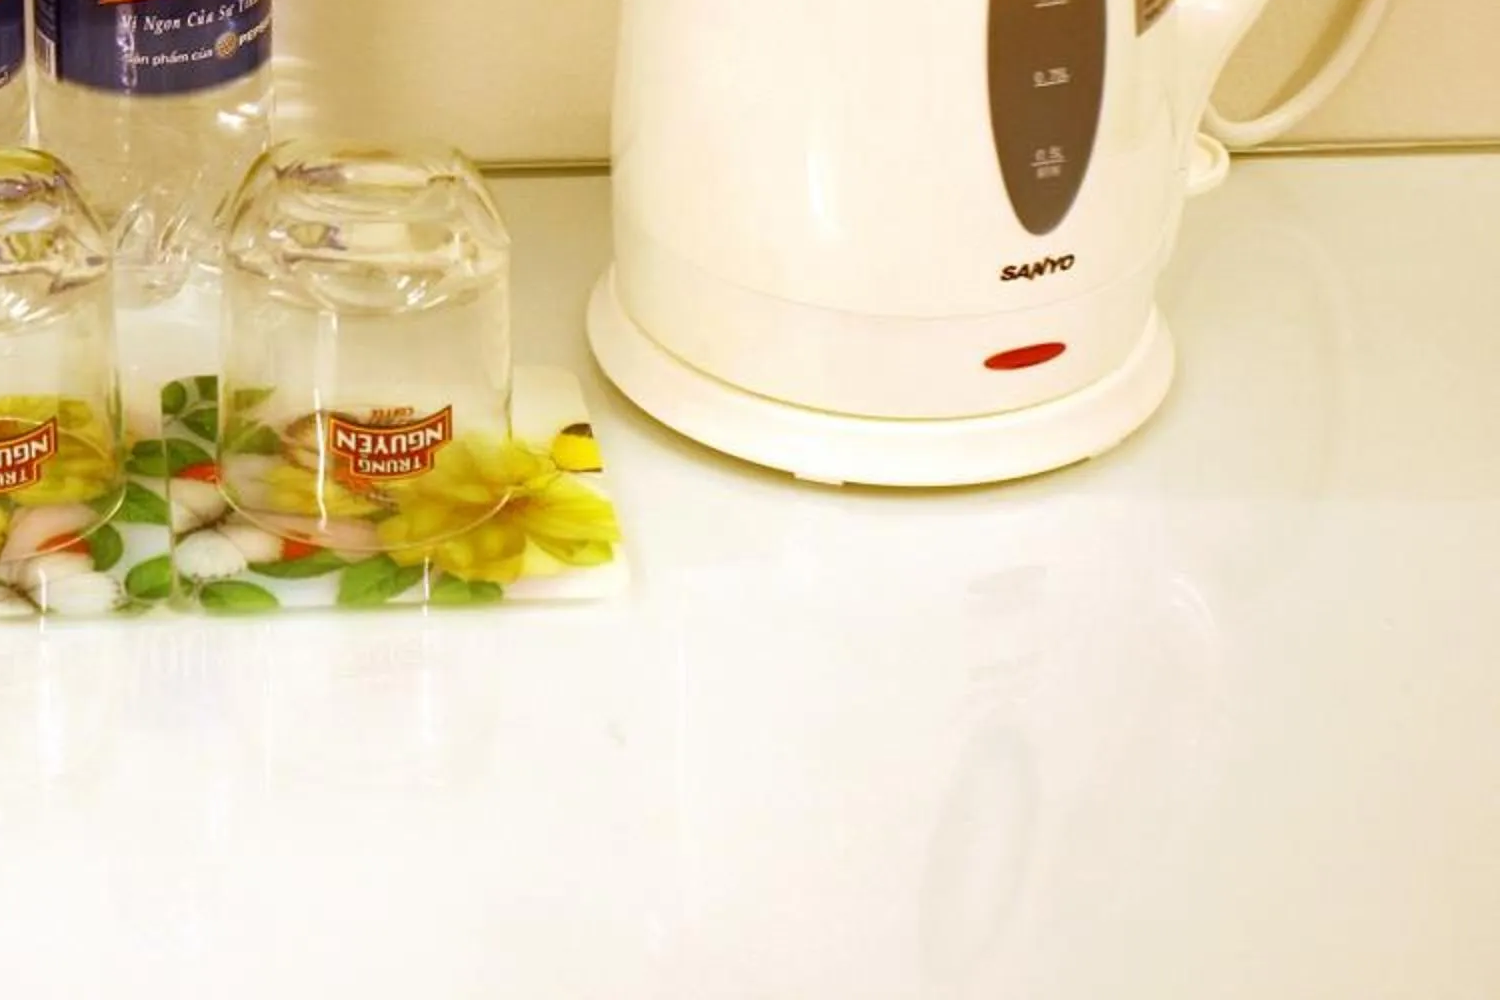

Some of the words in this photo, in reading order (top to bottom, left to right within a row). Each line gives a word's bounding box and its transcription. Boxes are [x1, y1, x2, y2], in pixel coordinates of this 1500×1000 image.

[143, 15, 181, 36] Ngon
[187, 8, 214, 28] Của
[1000, 253, 1075, 281] SANYO
